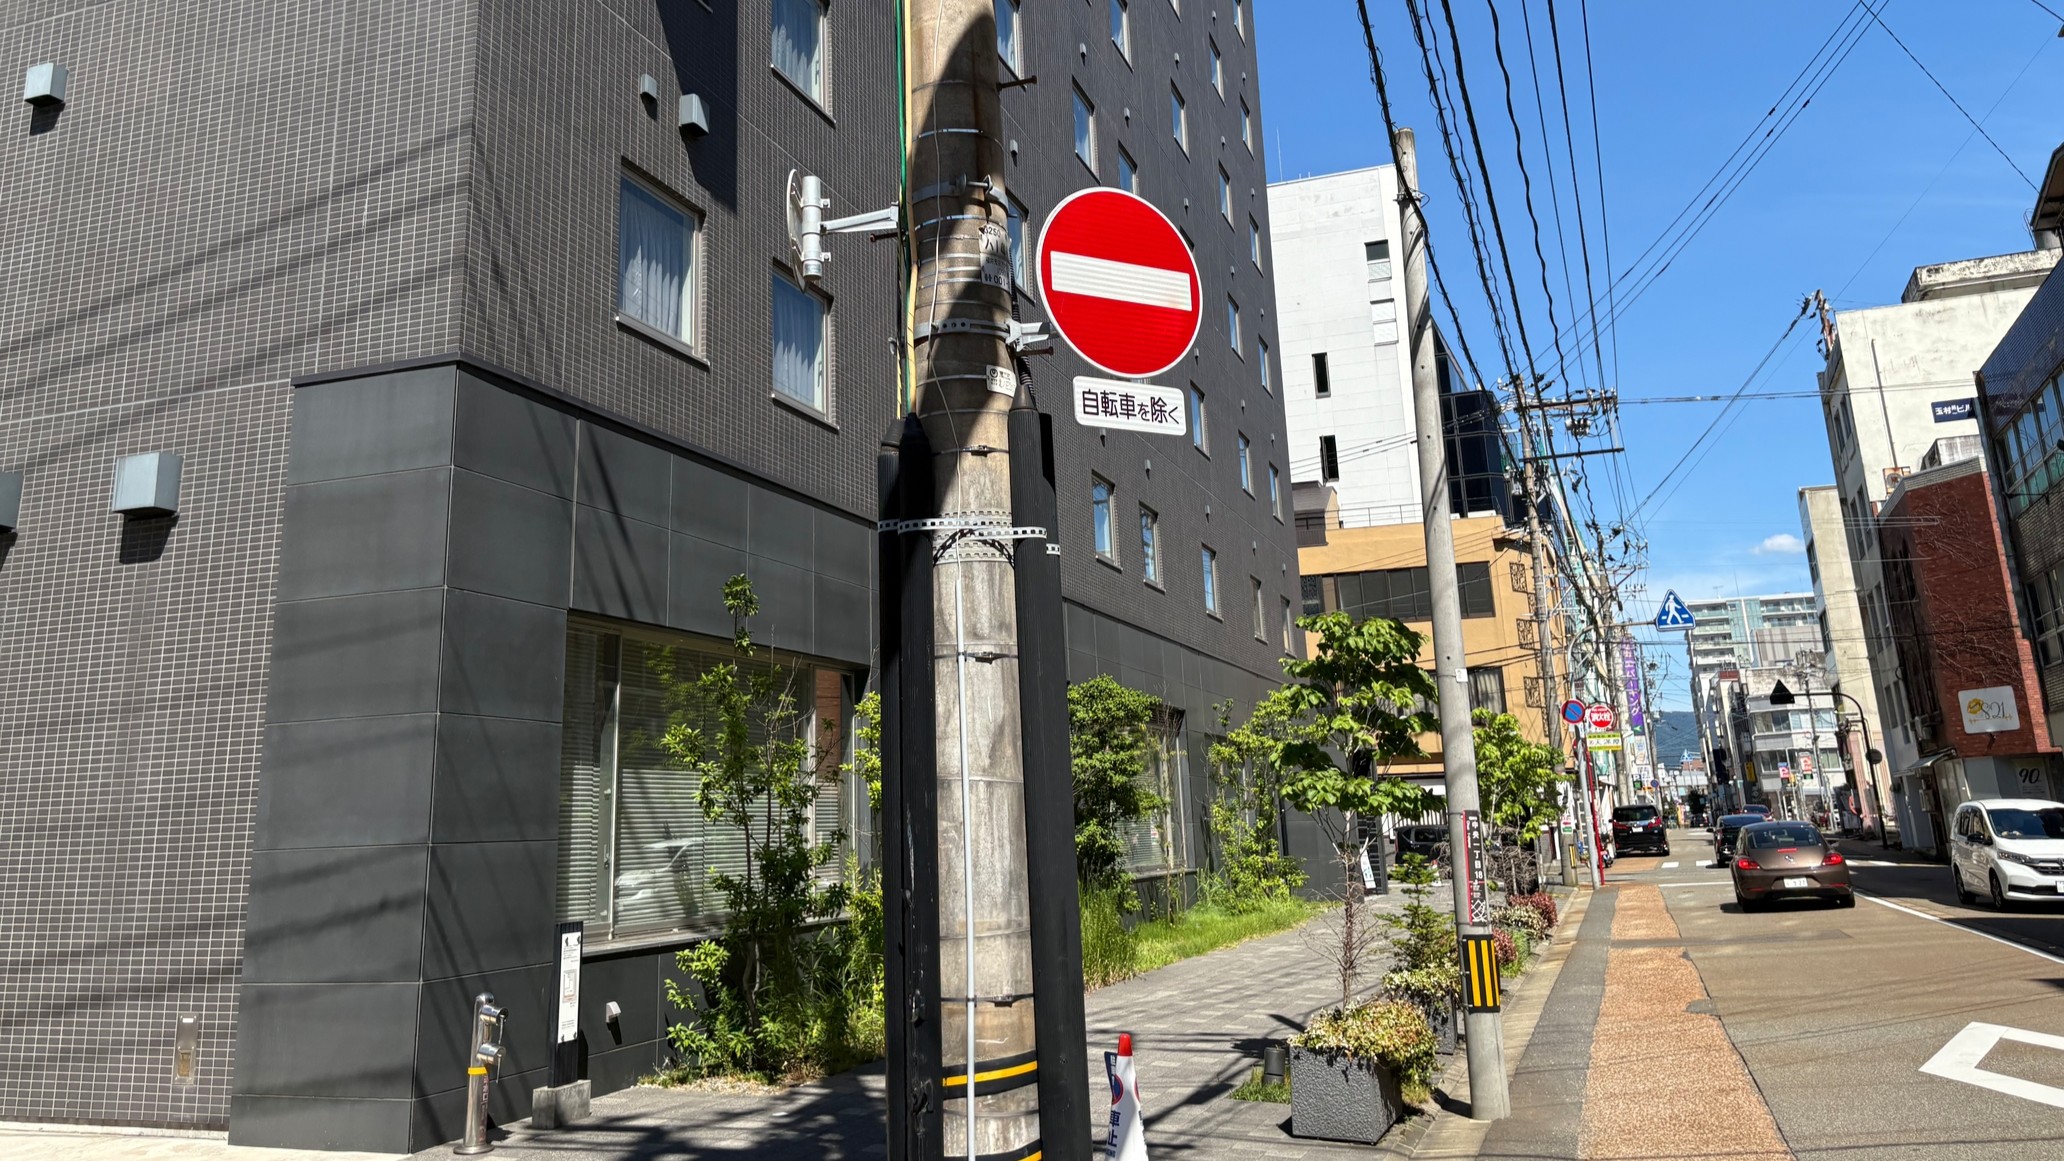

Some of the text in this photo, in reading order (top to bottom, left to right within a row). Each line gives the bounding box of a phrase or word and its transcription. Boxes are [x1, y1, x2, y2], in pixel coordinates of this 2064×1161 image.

[1082, 388, 1179, 425] 自転車を除く
[1981, 701, 2005, 720] 821
[2019, 768, 2040, 784] 90
